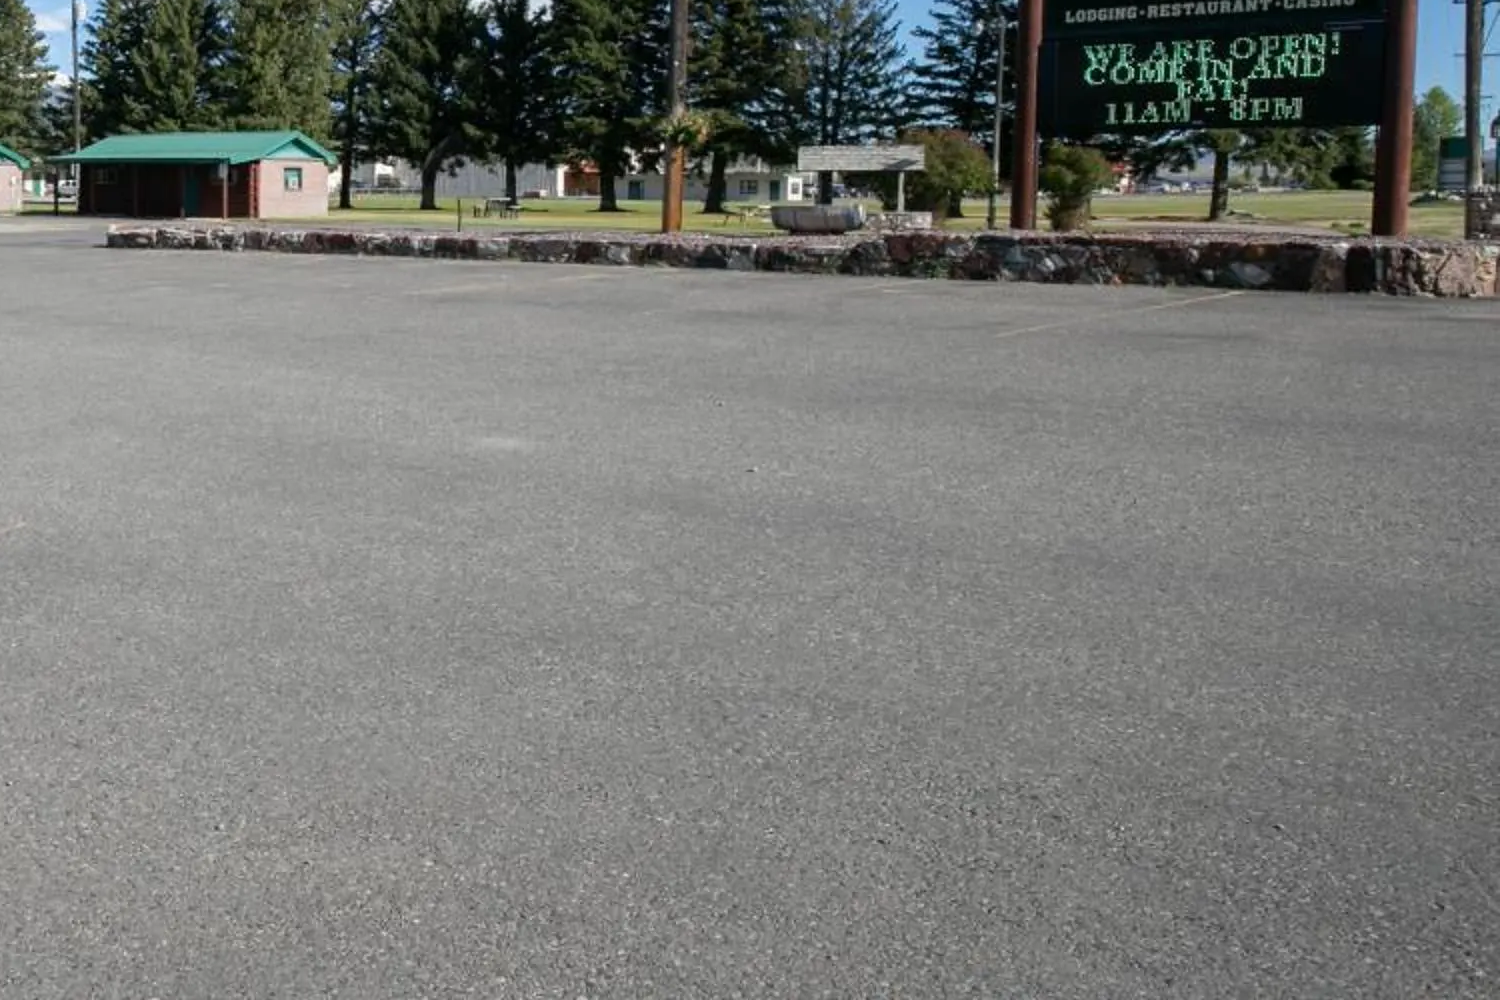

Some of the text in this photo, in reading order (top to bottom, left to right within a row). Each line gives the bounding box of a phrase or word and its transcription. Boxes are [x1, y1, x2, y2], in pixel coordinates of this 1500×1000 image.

[1065, 6, 1137, 23] LODGING
[1083, 31, 1341, 65] WE ARE OPEN!
[1083, 51, 1327, 85] COME IN AND
[1176, 77, 1250, 102] EAT!
[1104, 99, 1192, 124] 11AM
[1228, 96, 1304, 121] 8PM
